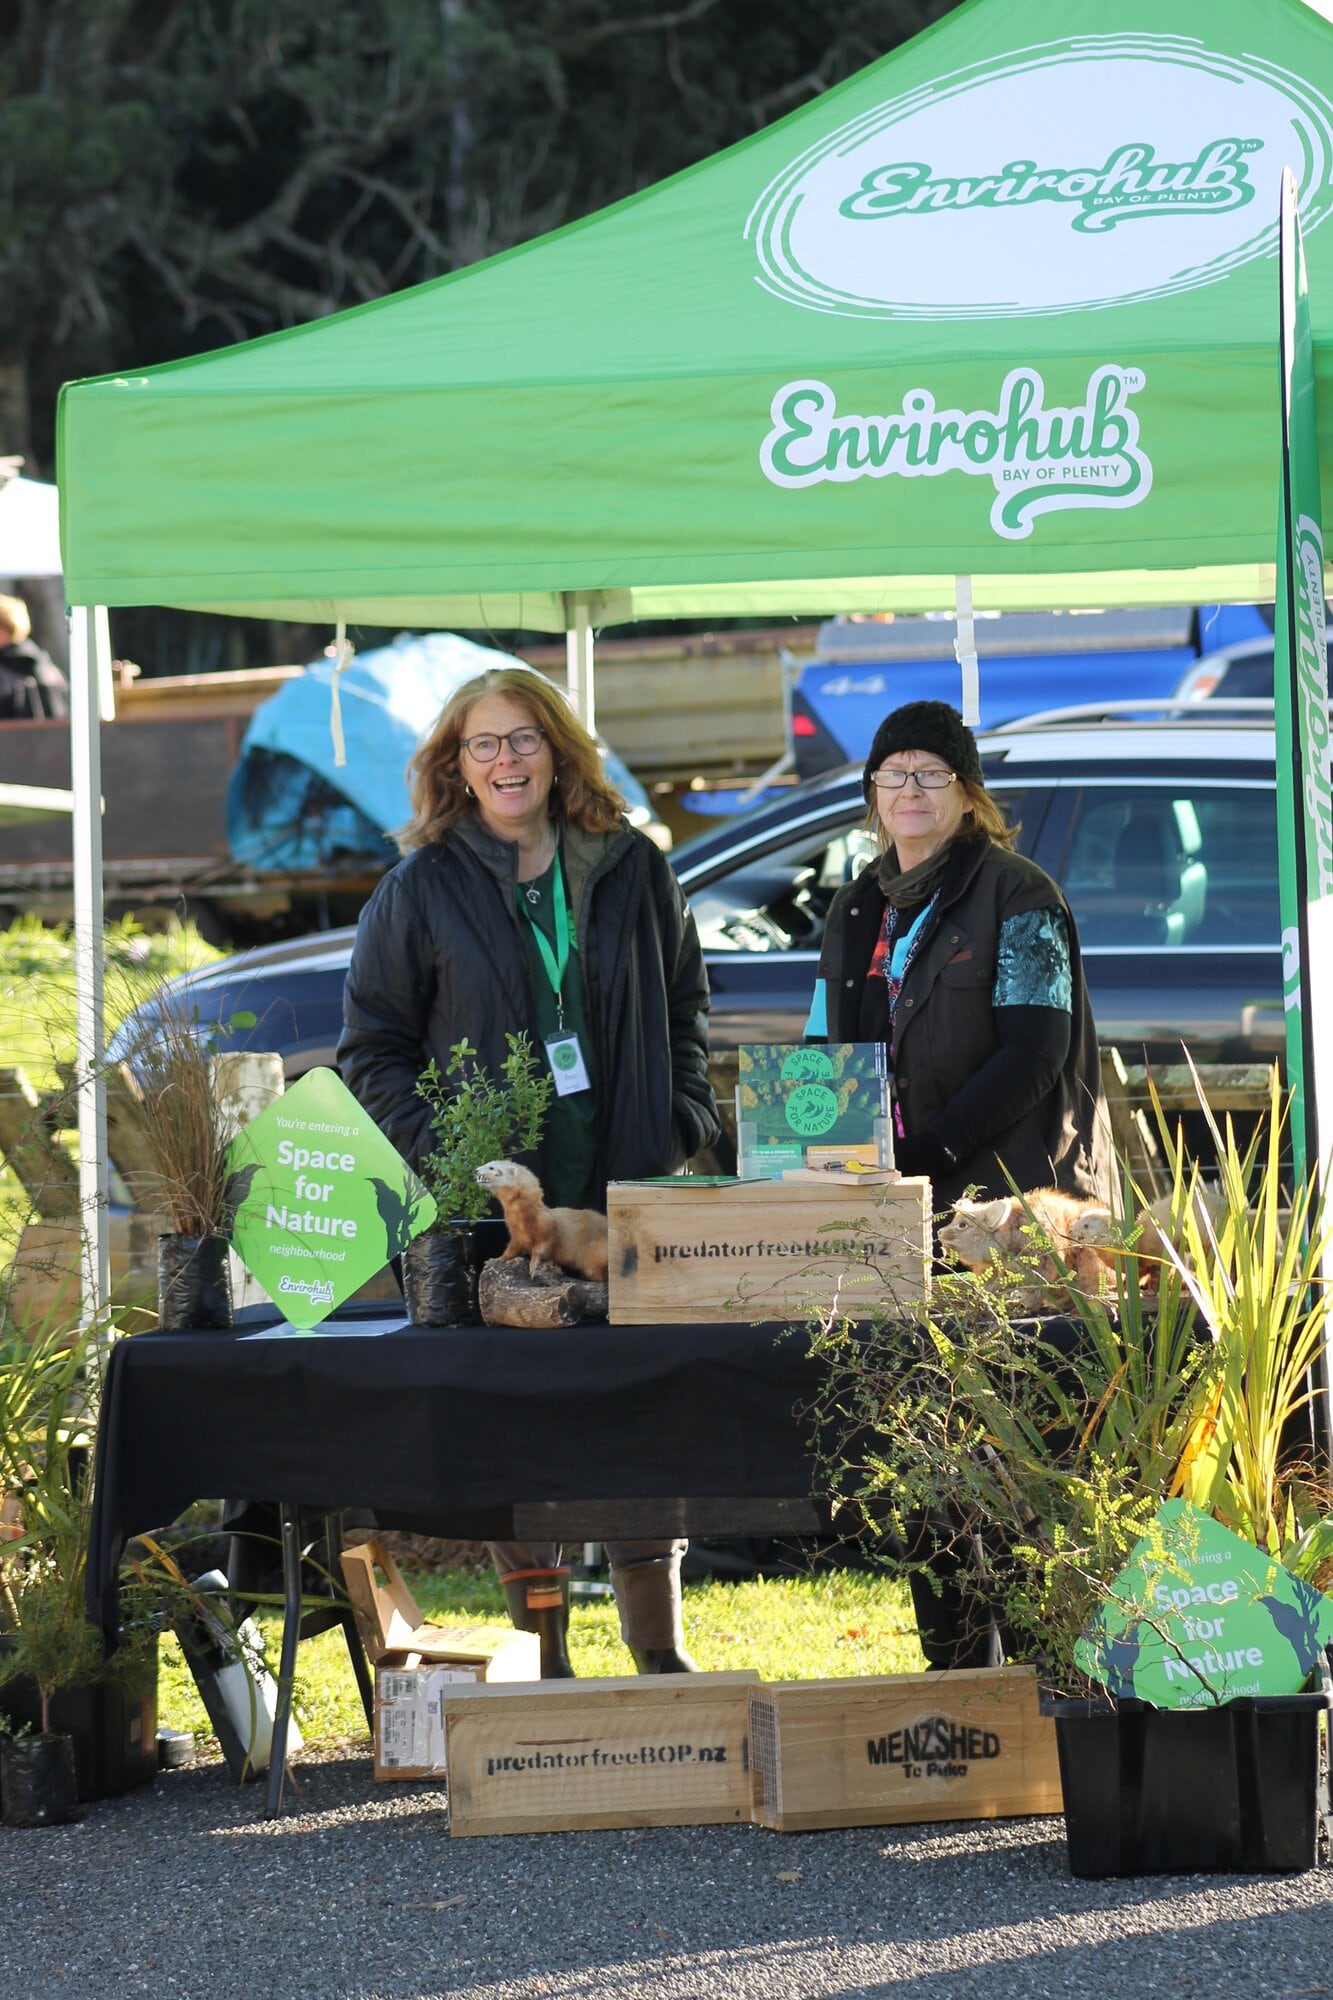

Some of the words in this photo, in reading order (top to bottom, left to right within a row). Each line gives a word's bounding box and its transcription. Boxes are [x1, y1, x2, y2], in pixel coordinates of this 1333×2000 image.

[851, 142, 1243, 229] Envirohub
[1093, 196, 1124, 206] BAY
[1129, 194, 1151, 203] OF
[1158, 191, 1221, 201] PLENTY
[771, 374, 1142, 529] Envirohub
[1002, 468, 1031, 481] BAY
[1036, 467, 1055, 480] OF
[1062, 465, 1120, 479] PLENTY
[1306, 555, 1325, 632] PLENTY
[790, 1053, 823, 1066] SPACE
[795, 1088, 828, 1101] SPACE
[276, 1116, 306, 1130] You're
[308, 1122, 350, 1137] entering
[352, 1127, 359, 1136] a
[789, 1106, 802, 1127] FOR
[803, 1105, 835, 1132] NATURE
[277, 1140, 356, 1172] Space
[295, 1174, 334, 1202] for
[266, 1204, 357, 1238] Nature
[269, 1244, 346, 1262] neighbourhood
[1225, 1551, 1232, 1561] a
[1154, 1580, 1238, 1611] Space
[1184, 1615, 1225, 1641] for
[1162, 1647, 1264, 1681] Nature
[867, 1717, 1001, 1765] MENZSHED
[487, 1745, 728, 1776] predatorfreeBOP.nz
